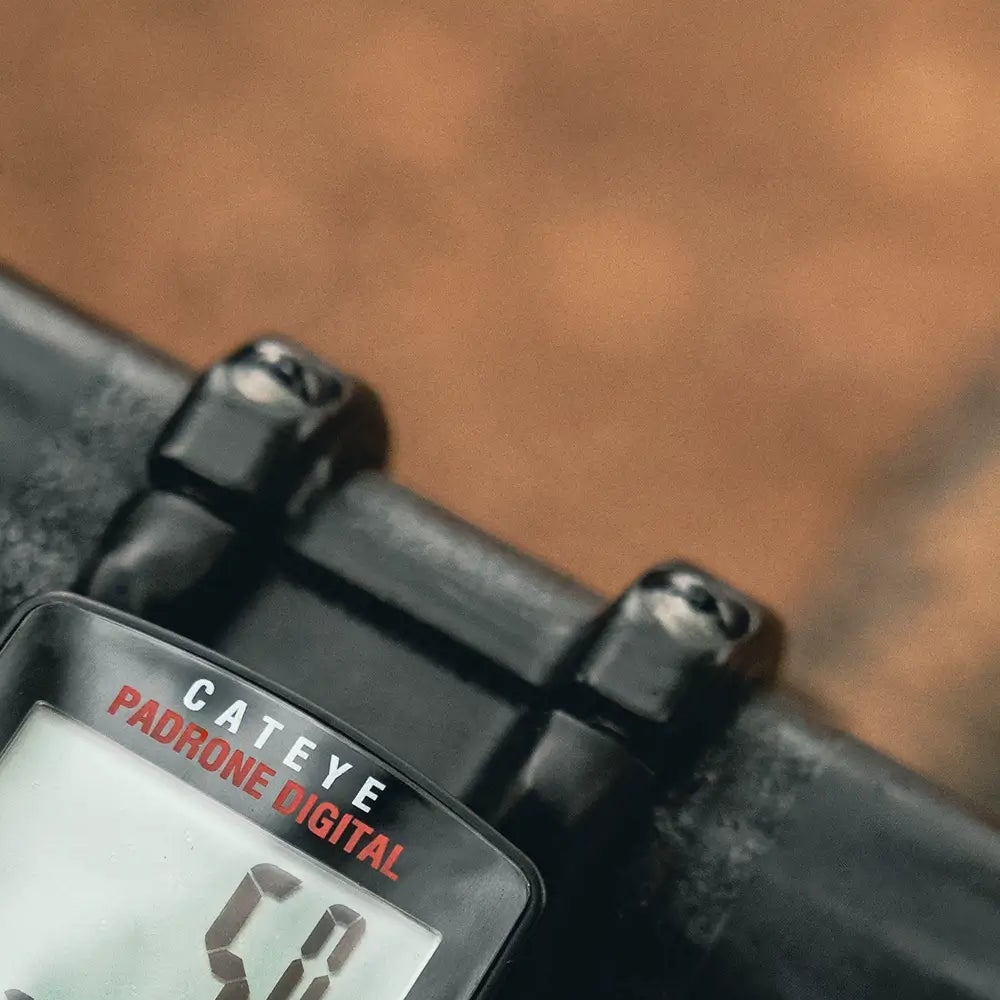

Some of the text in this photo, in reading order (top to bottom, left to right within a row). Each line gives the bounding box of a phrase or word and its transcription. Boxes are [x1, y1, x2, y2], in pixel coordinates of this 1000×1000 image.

[106, 684, 405, 882] PADRONE DIGITAL
[182, 677, 387, 814] CATEYE
